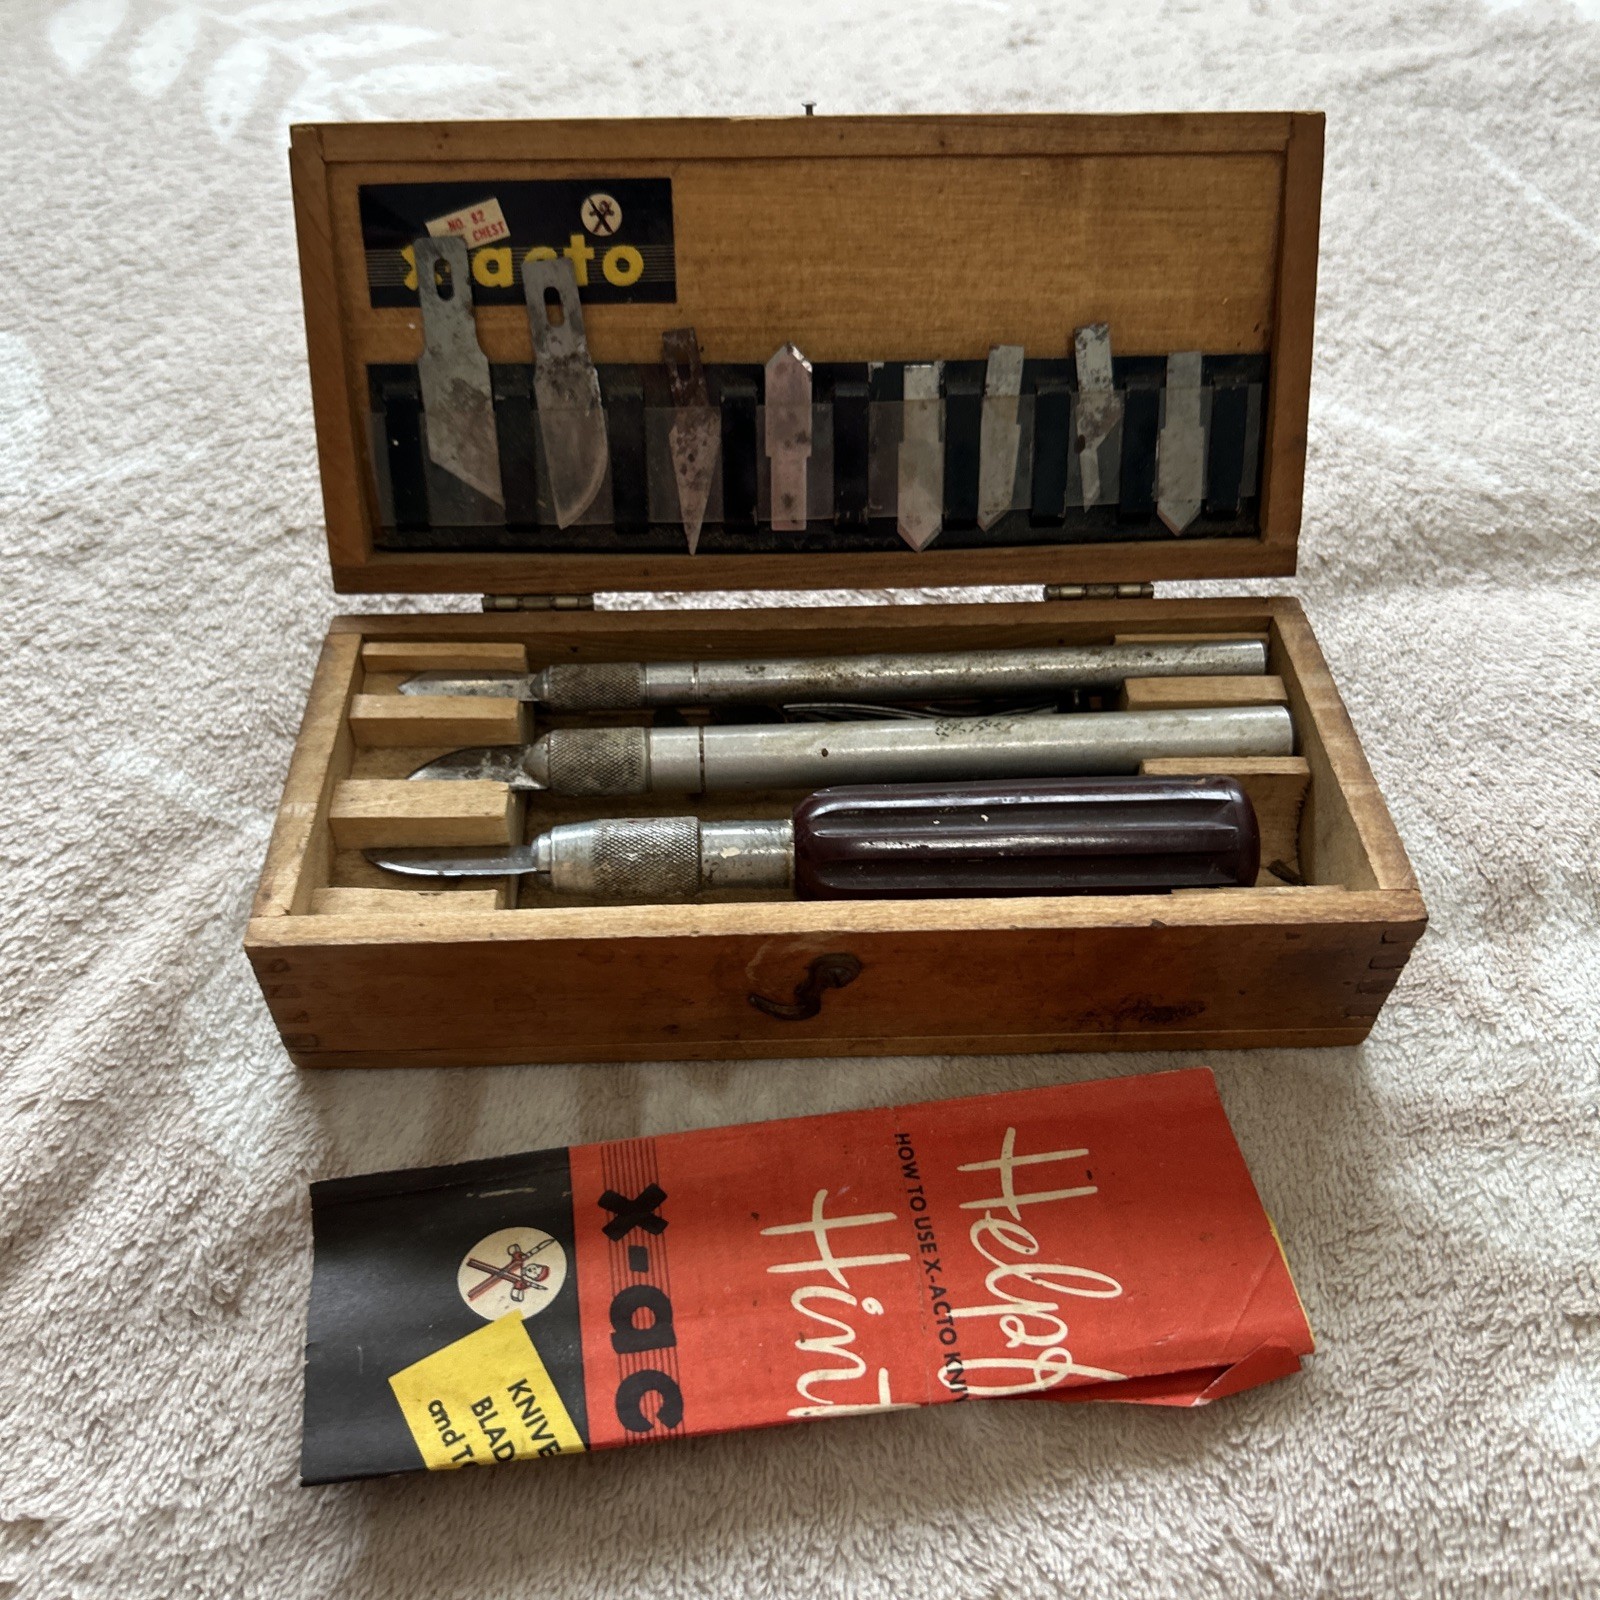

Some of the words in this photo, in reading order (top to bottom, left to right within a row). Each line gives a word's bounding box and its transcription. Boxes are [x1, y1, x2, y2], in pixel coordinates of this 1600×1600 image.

[472, 221, 505, 242] CHEST
[894, 1133, 921, 1180] HOW
[907, 1185, 927, 1212] TO
[914, 1216, 937, 1253] USE
[923, 1258, 957, 1345] X-ACTO
[428, 1399, 466, 1447] and
[451, 1444, 479, 1468] T
